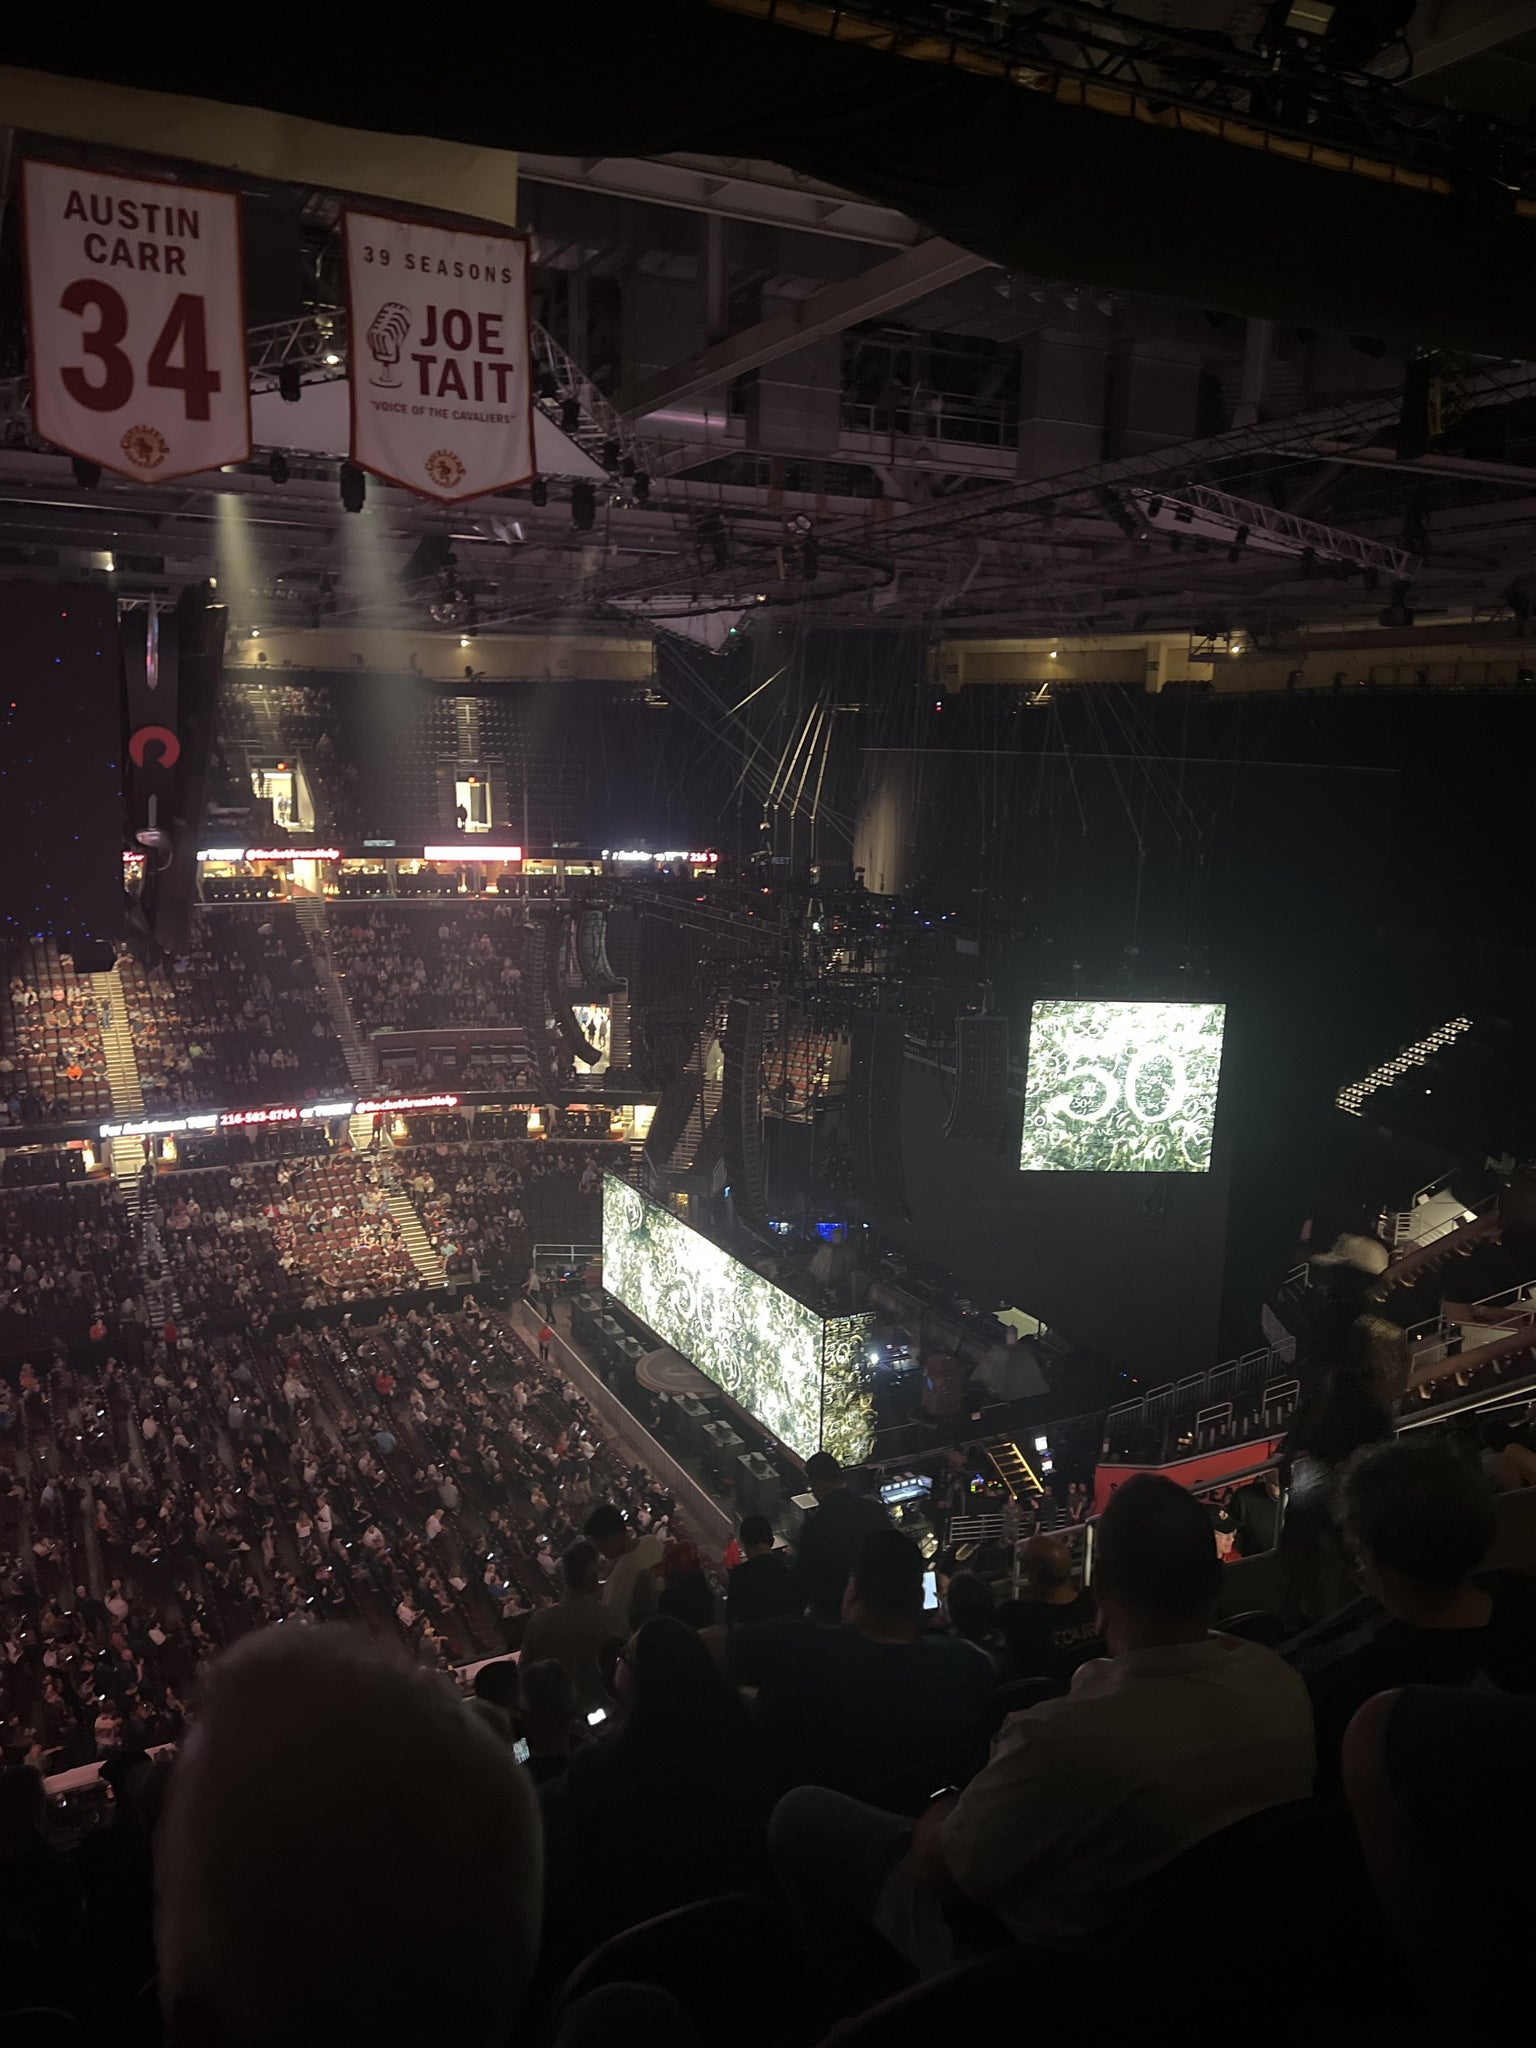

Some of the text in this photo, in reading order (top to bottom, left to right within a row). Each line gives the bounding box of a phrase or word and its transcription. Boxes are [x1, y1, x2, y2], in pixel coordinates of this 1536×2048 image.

[64, 190, 200, 239] AUSTIN
[84, 233, 187, 275] CARR
[363, 245, 513, 284] 39 SEASONS
[60, 278, 221, 421] 34
[420, 305, 503, 355] JOE
[411, 353, 513, 404] TAIT
[411, 405, 427, 416] OF
[428, 407, 449, 419] THE
